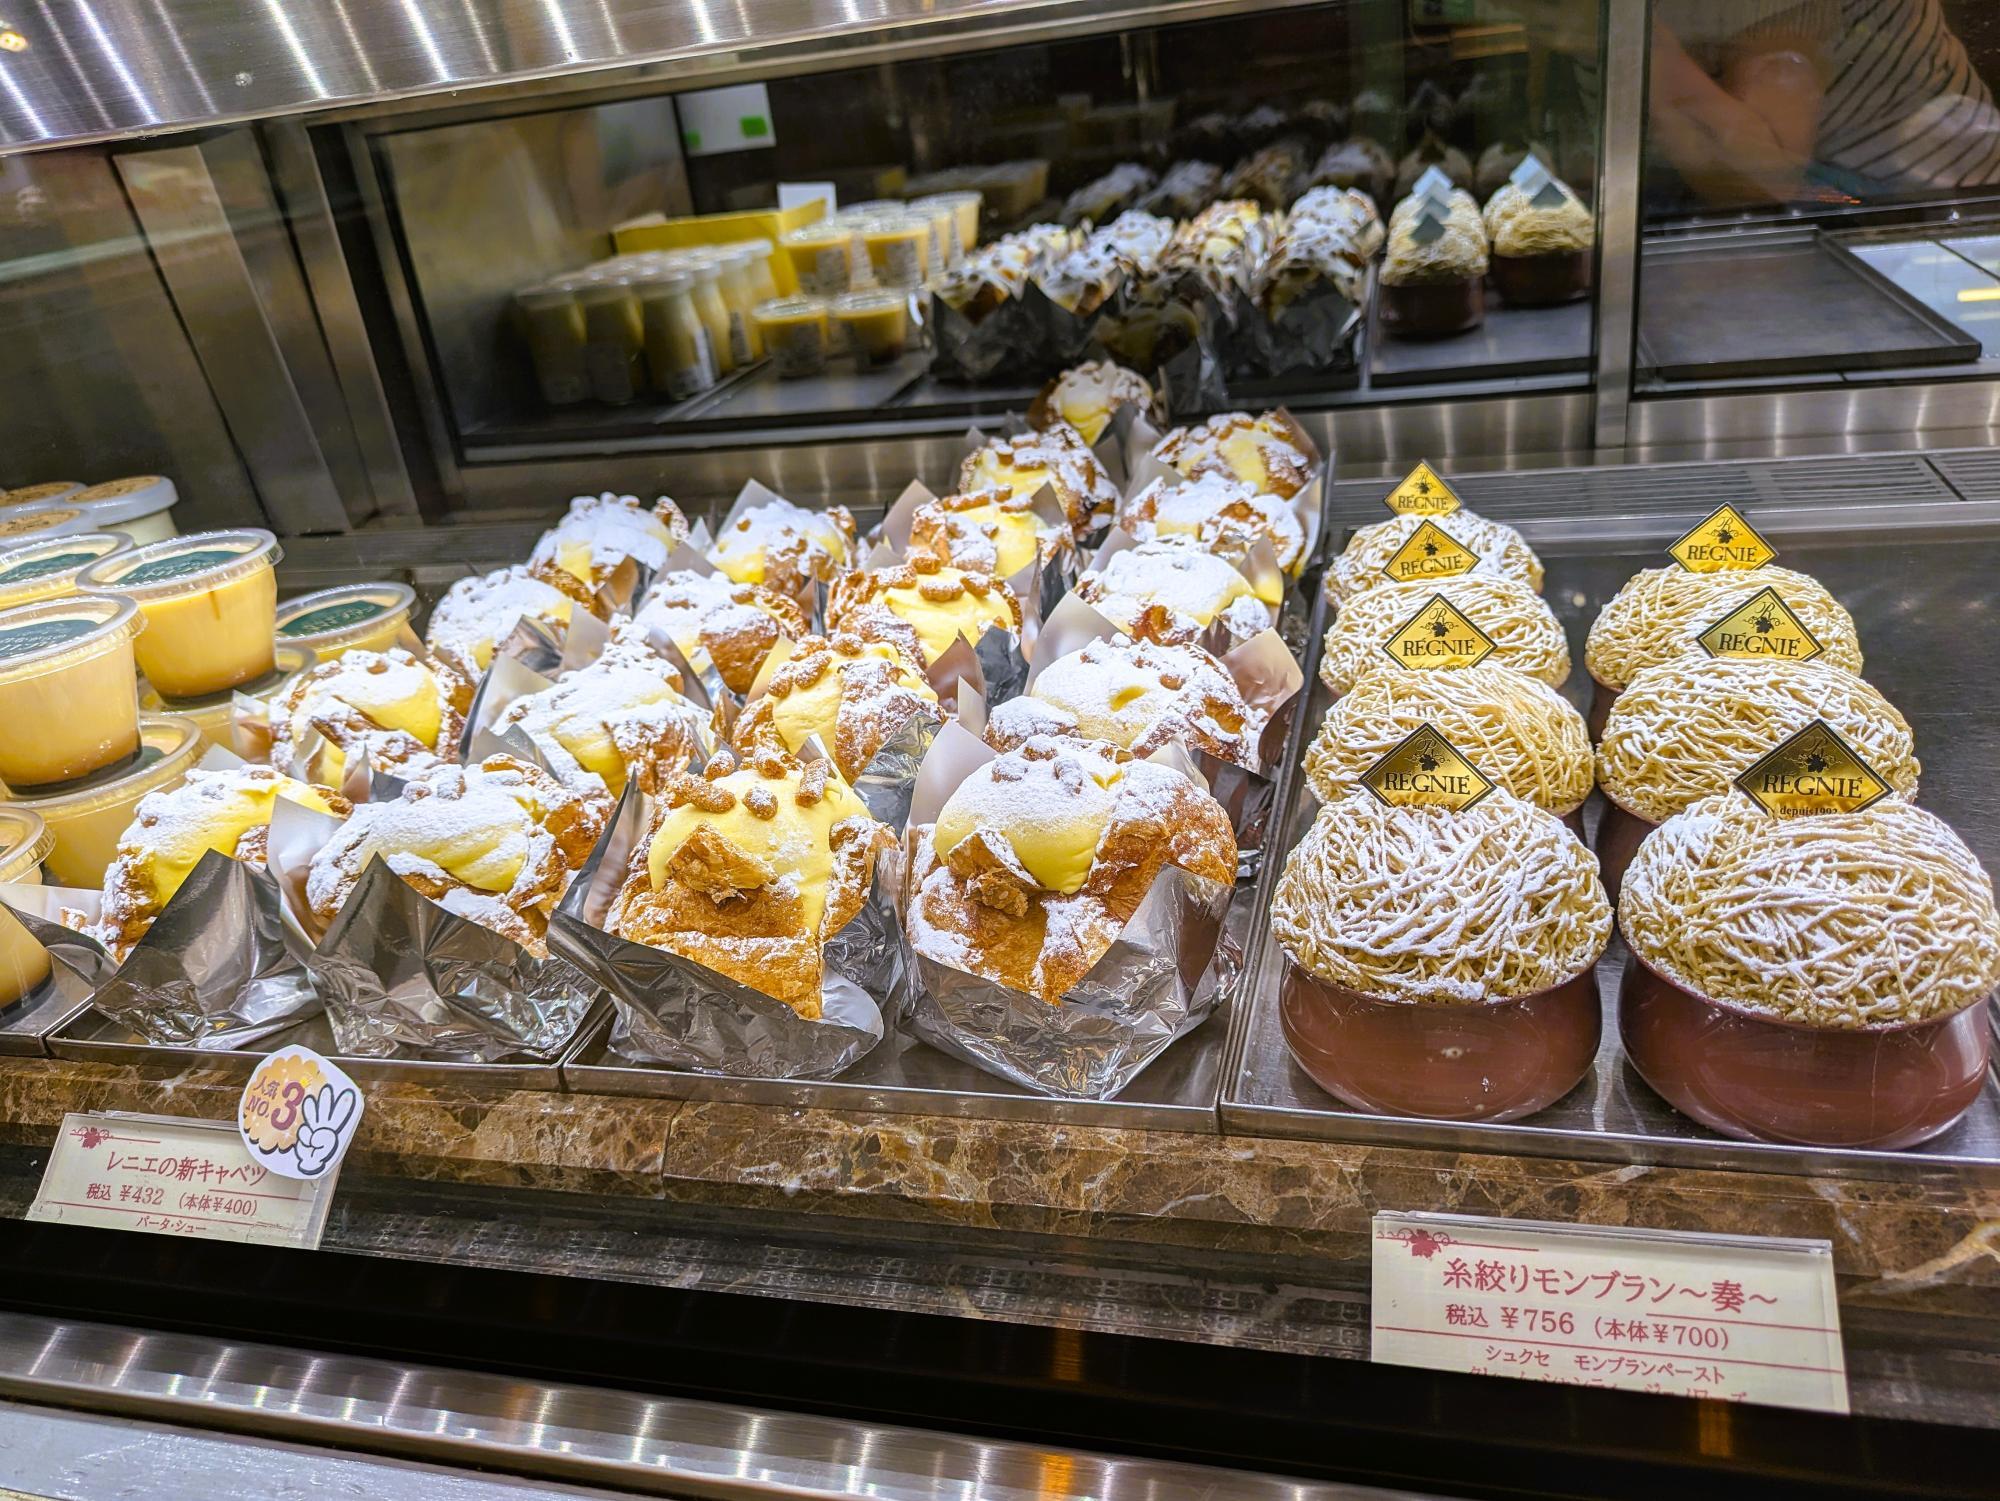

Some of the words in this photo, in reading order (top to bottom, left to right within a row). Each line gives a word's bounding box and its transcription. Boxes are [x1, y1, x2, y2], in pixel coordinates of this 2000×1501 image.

[1397, 493, 1449, 511] RÉGNIÉ
[1400, 553, 1464, 577] RÉGNIÉ
[1686, 544, 1757, 563] RÉGNIÉ
[1402, 637, 1476, 657] RÉGNIÉ
[1718, 630, 1801, 658] RÉGNIÉ
[1383, 769, 1471, 796] RÉGNIÉ
[1761, 771, 1863, 799] RÉGNIÉ
[253, 1075, 281, 1101] 人気
[270, 1081, 305, 1131] 3
[86, 1182, 113, 1202] 税込
[119, 1184, 165, 1206] ¥432
[1445, 1303, 1489, 1330] 税込
[1500, 1306, 1575, 1336] ¥756
[1484, 1344, 1551, 1368] シュクセ
[1573, 1353, 1726, 1385] モンブランペースト
